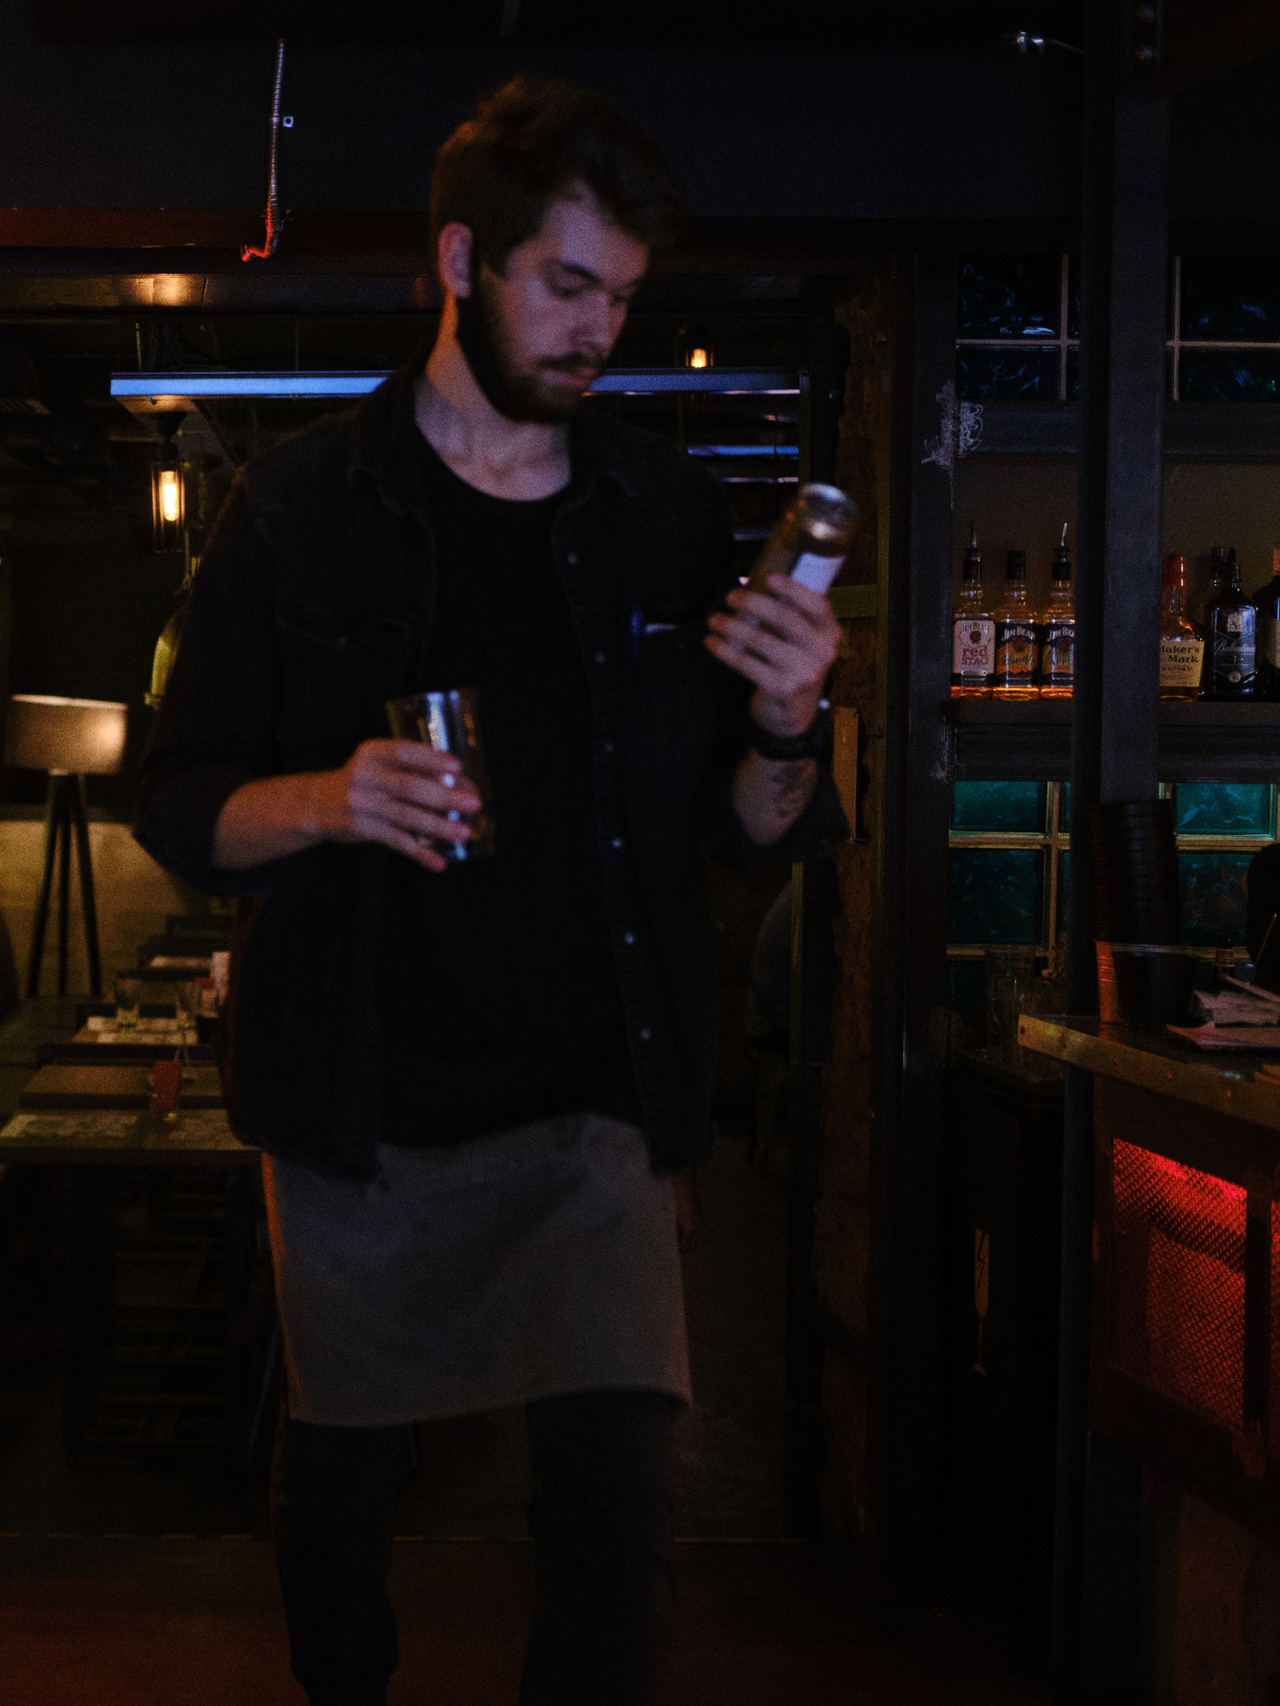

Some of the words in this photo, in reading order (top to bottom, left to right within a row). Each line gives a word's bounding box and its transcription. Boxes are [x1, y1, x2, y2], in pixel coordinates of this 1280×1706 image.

[1001, 628, 1016, 642] JIM
[1016, 625, 1036, 641] BEAM
[1047, 628, 1061, 643] JIM
[1062, 626, 1075, 638] BEA
[962, 644, 988, 657] red
[961, 657, 989, 665] STAG
[1167, 655, 1200, 663] Mark
